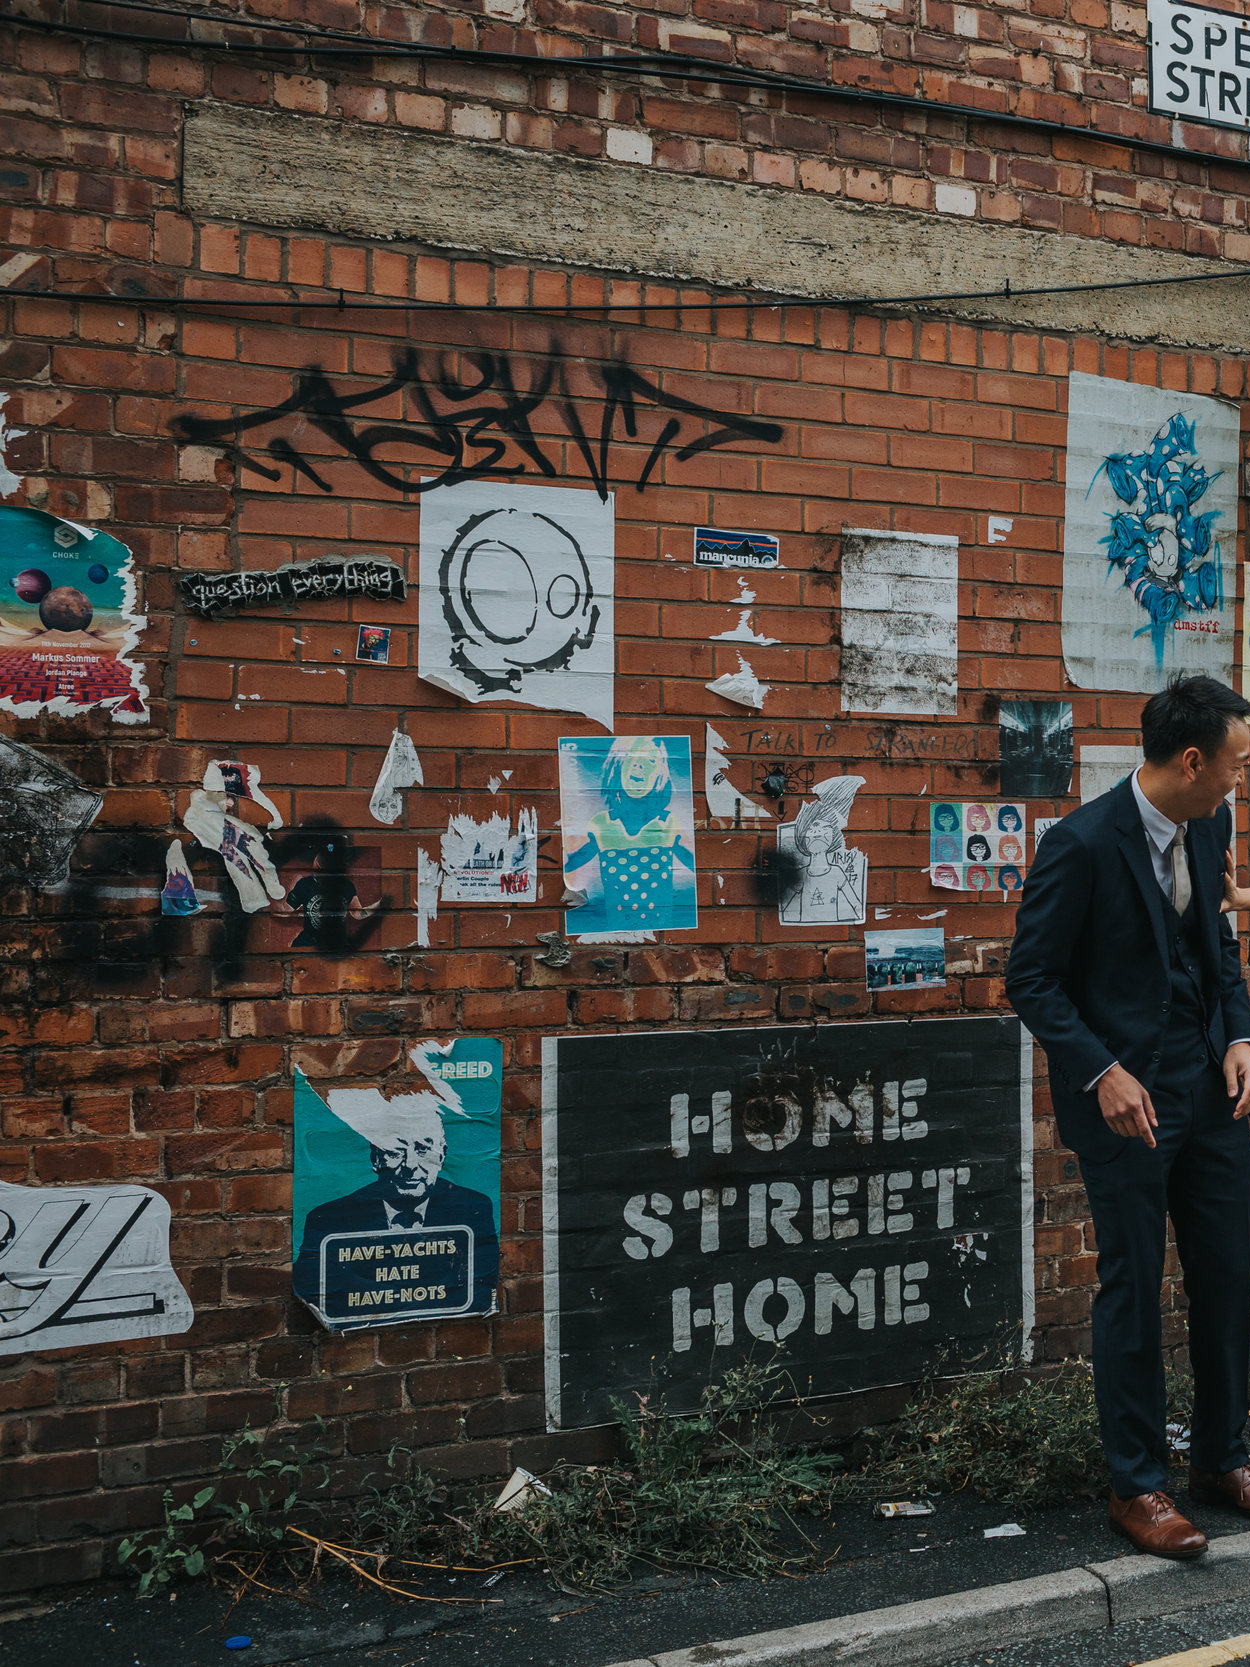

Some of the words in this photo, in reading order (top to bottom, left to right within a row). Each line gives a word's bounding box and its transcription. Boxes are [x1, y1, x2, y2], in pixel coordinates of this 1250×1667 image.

[192, 573, 281, 606] question
[292, 562, 393, 594] everything
[1173, 618, 1220, 633] dmstff
[32, 653, 64, 662] Markus
[65, 654, 100, 663] Sommer
[741, 729, 795, 752] TALK
[814, 732, 837, 751] TO
[428, 1061, 493, 1079] GREED
[669, 1077, 930, 1159] HOME
[622, 1166, 971, 1261] STREET
[338, 1240, 457, 1263] HAVE-YACHTS
[375, 1265, 420, 1282] HATE
[348, 1285, 446, 1307] HAVE-NOTS
[671, 1261, 930, 1352] HOME
